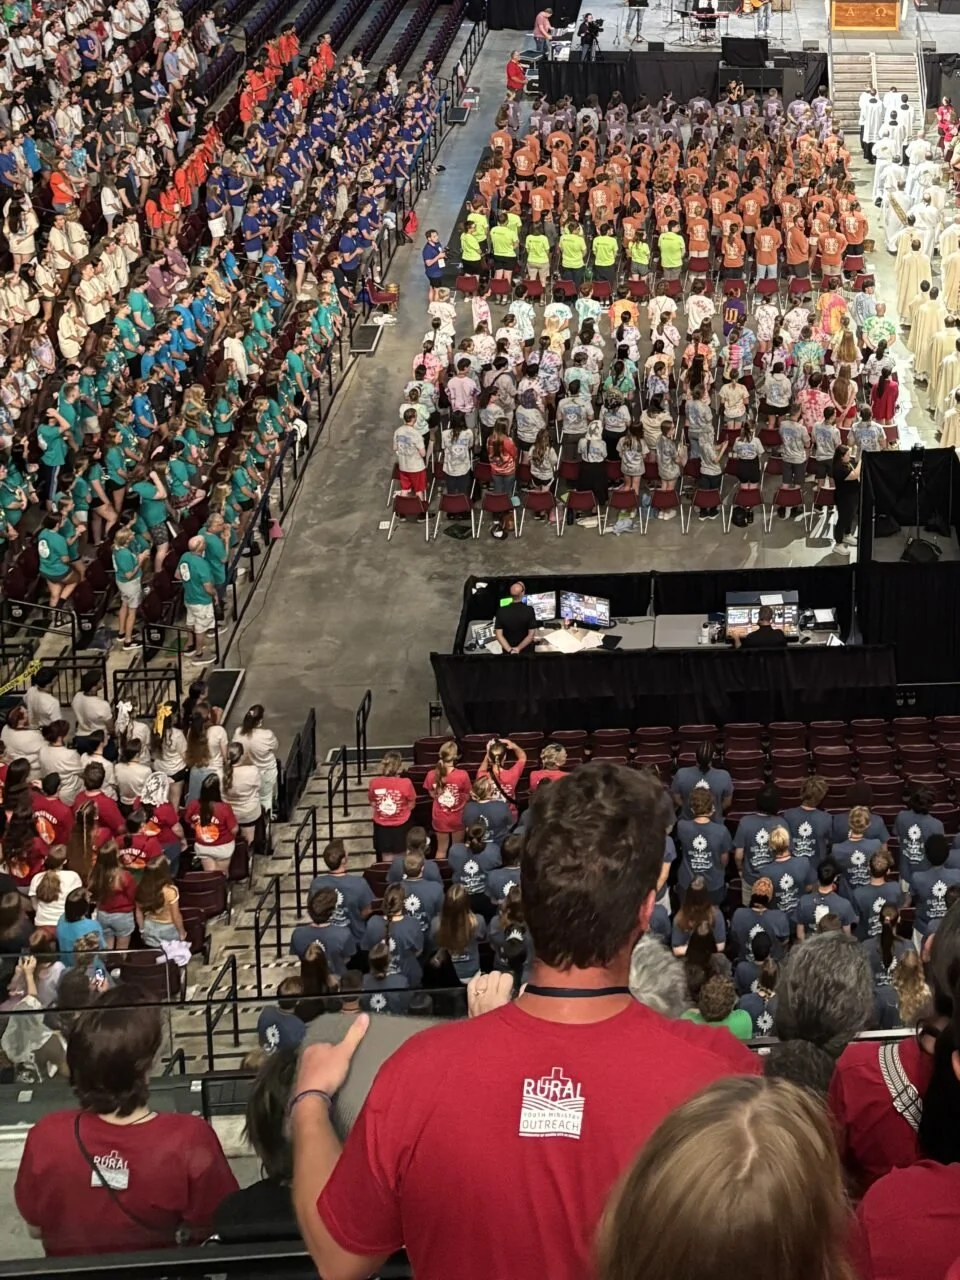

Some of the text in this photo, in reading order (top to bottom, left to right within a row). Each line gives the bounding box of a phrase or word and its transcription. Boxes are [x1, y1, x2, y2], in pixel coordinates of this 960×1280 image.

[875, 6, 887, 17] Ω
[523, 1078, 586, 1100] RURAL
[548, 1112, 580, 1120] MINISTRY
[522, 1119, 580, 1131] OUTREACH
[94, 1156, 128, 1170] RURAL
